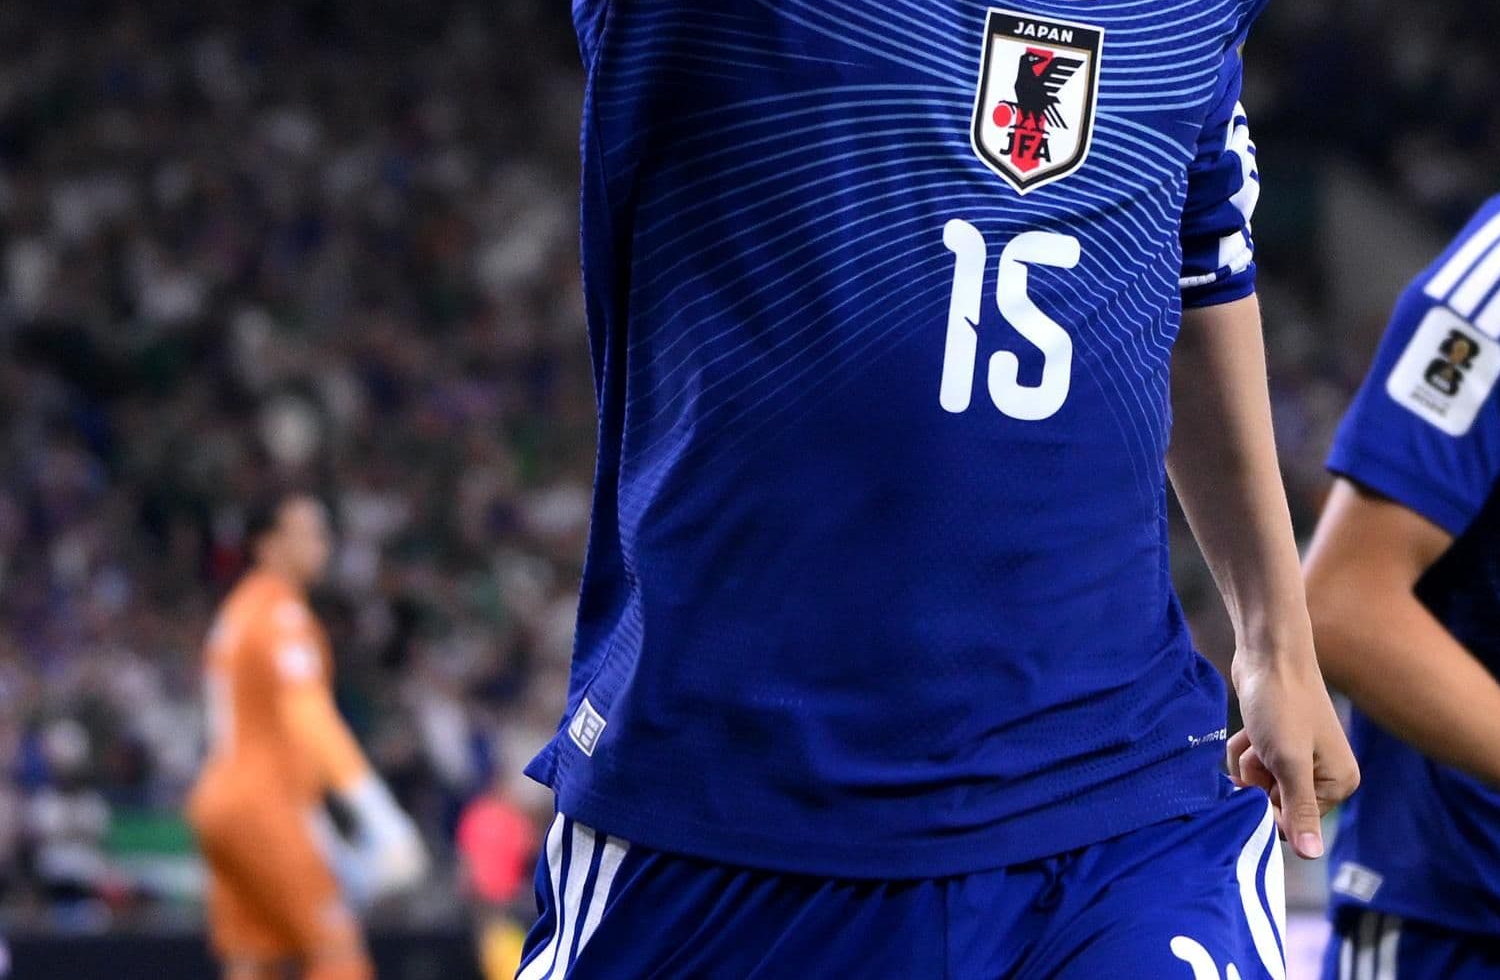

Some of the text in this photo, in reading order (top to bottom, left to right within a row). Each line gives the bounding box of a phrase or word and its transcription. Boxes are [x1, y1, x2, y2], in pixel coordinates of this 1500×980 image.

[1013, 21, 1074, 44] JAPAN
[999, 131, 1052, 163] JFA
[939, 218, 1082, 421] 15
